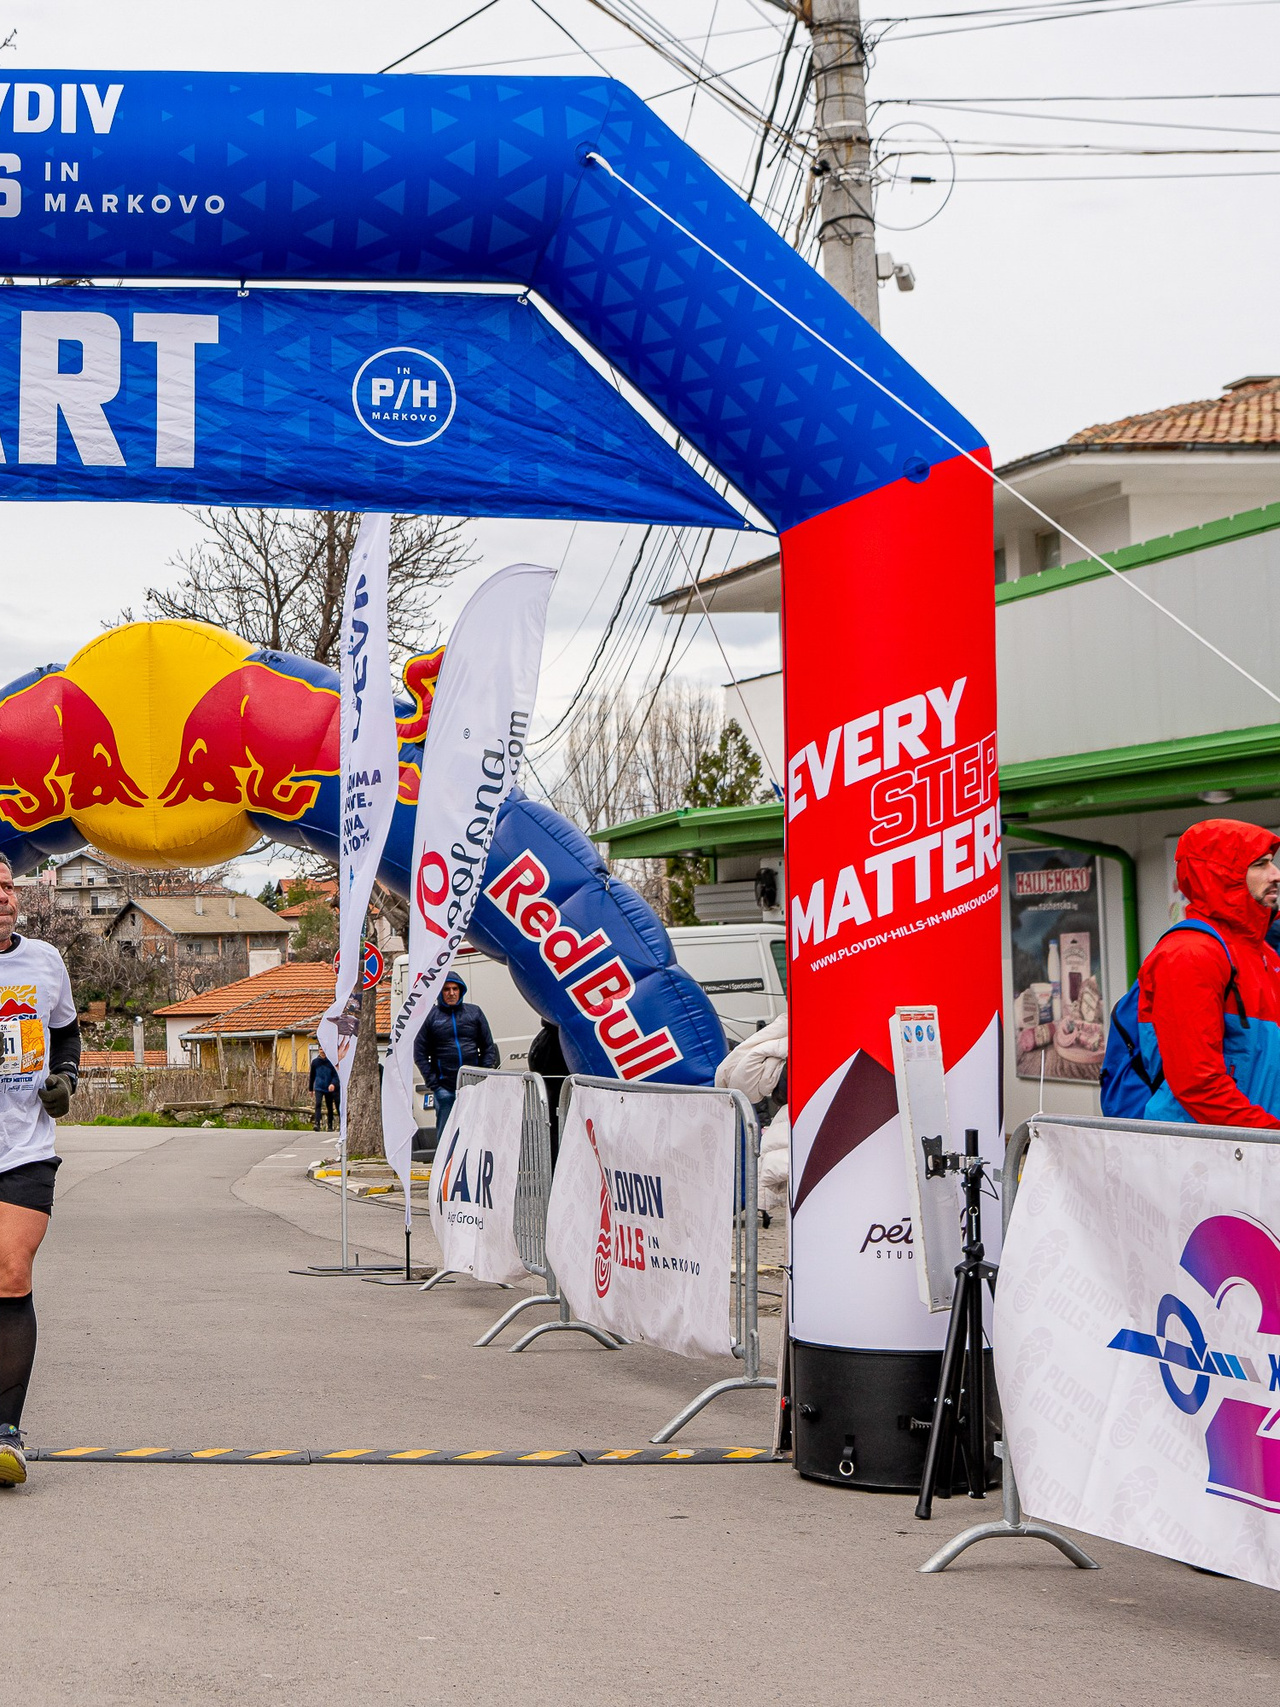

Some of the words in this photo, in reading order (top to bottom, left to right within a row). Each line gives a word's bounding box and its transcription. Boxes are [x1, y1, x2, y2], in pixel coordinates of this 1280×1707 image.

[44, 161, 79, 182] IN
[44, 193, 226, 214] MARKOVO
[397, 366, 411, 375] IN
[371, 377, 437, 410] P/H
[371, 411, 437, 422] MARKOVO
[788, 676, 968, 824] EVERY
[869, 730, 999, 848] STEP
[791, 796, 1002, 962] MATTER
[488, 853, 607, 976] Red
[570, 960, 678, 1081] Bull
[509, 1052, 529, 1060] DUC
[876, 1250, 915, 1260] STUD
